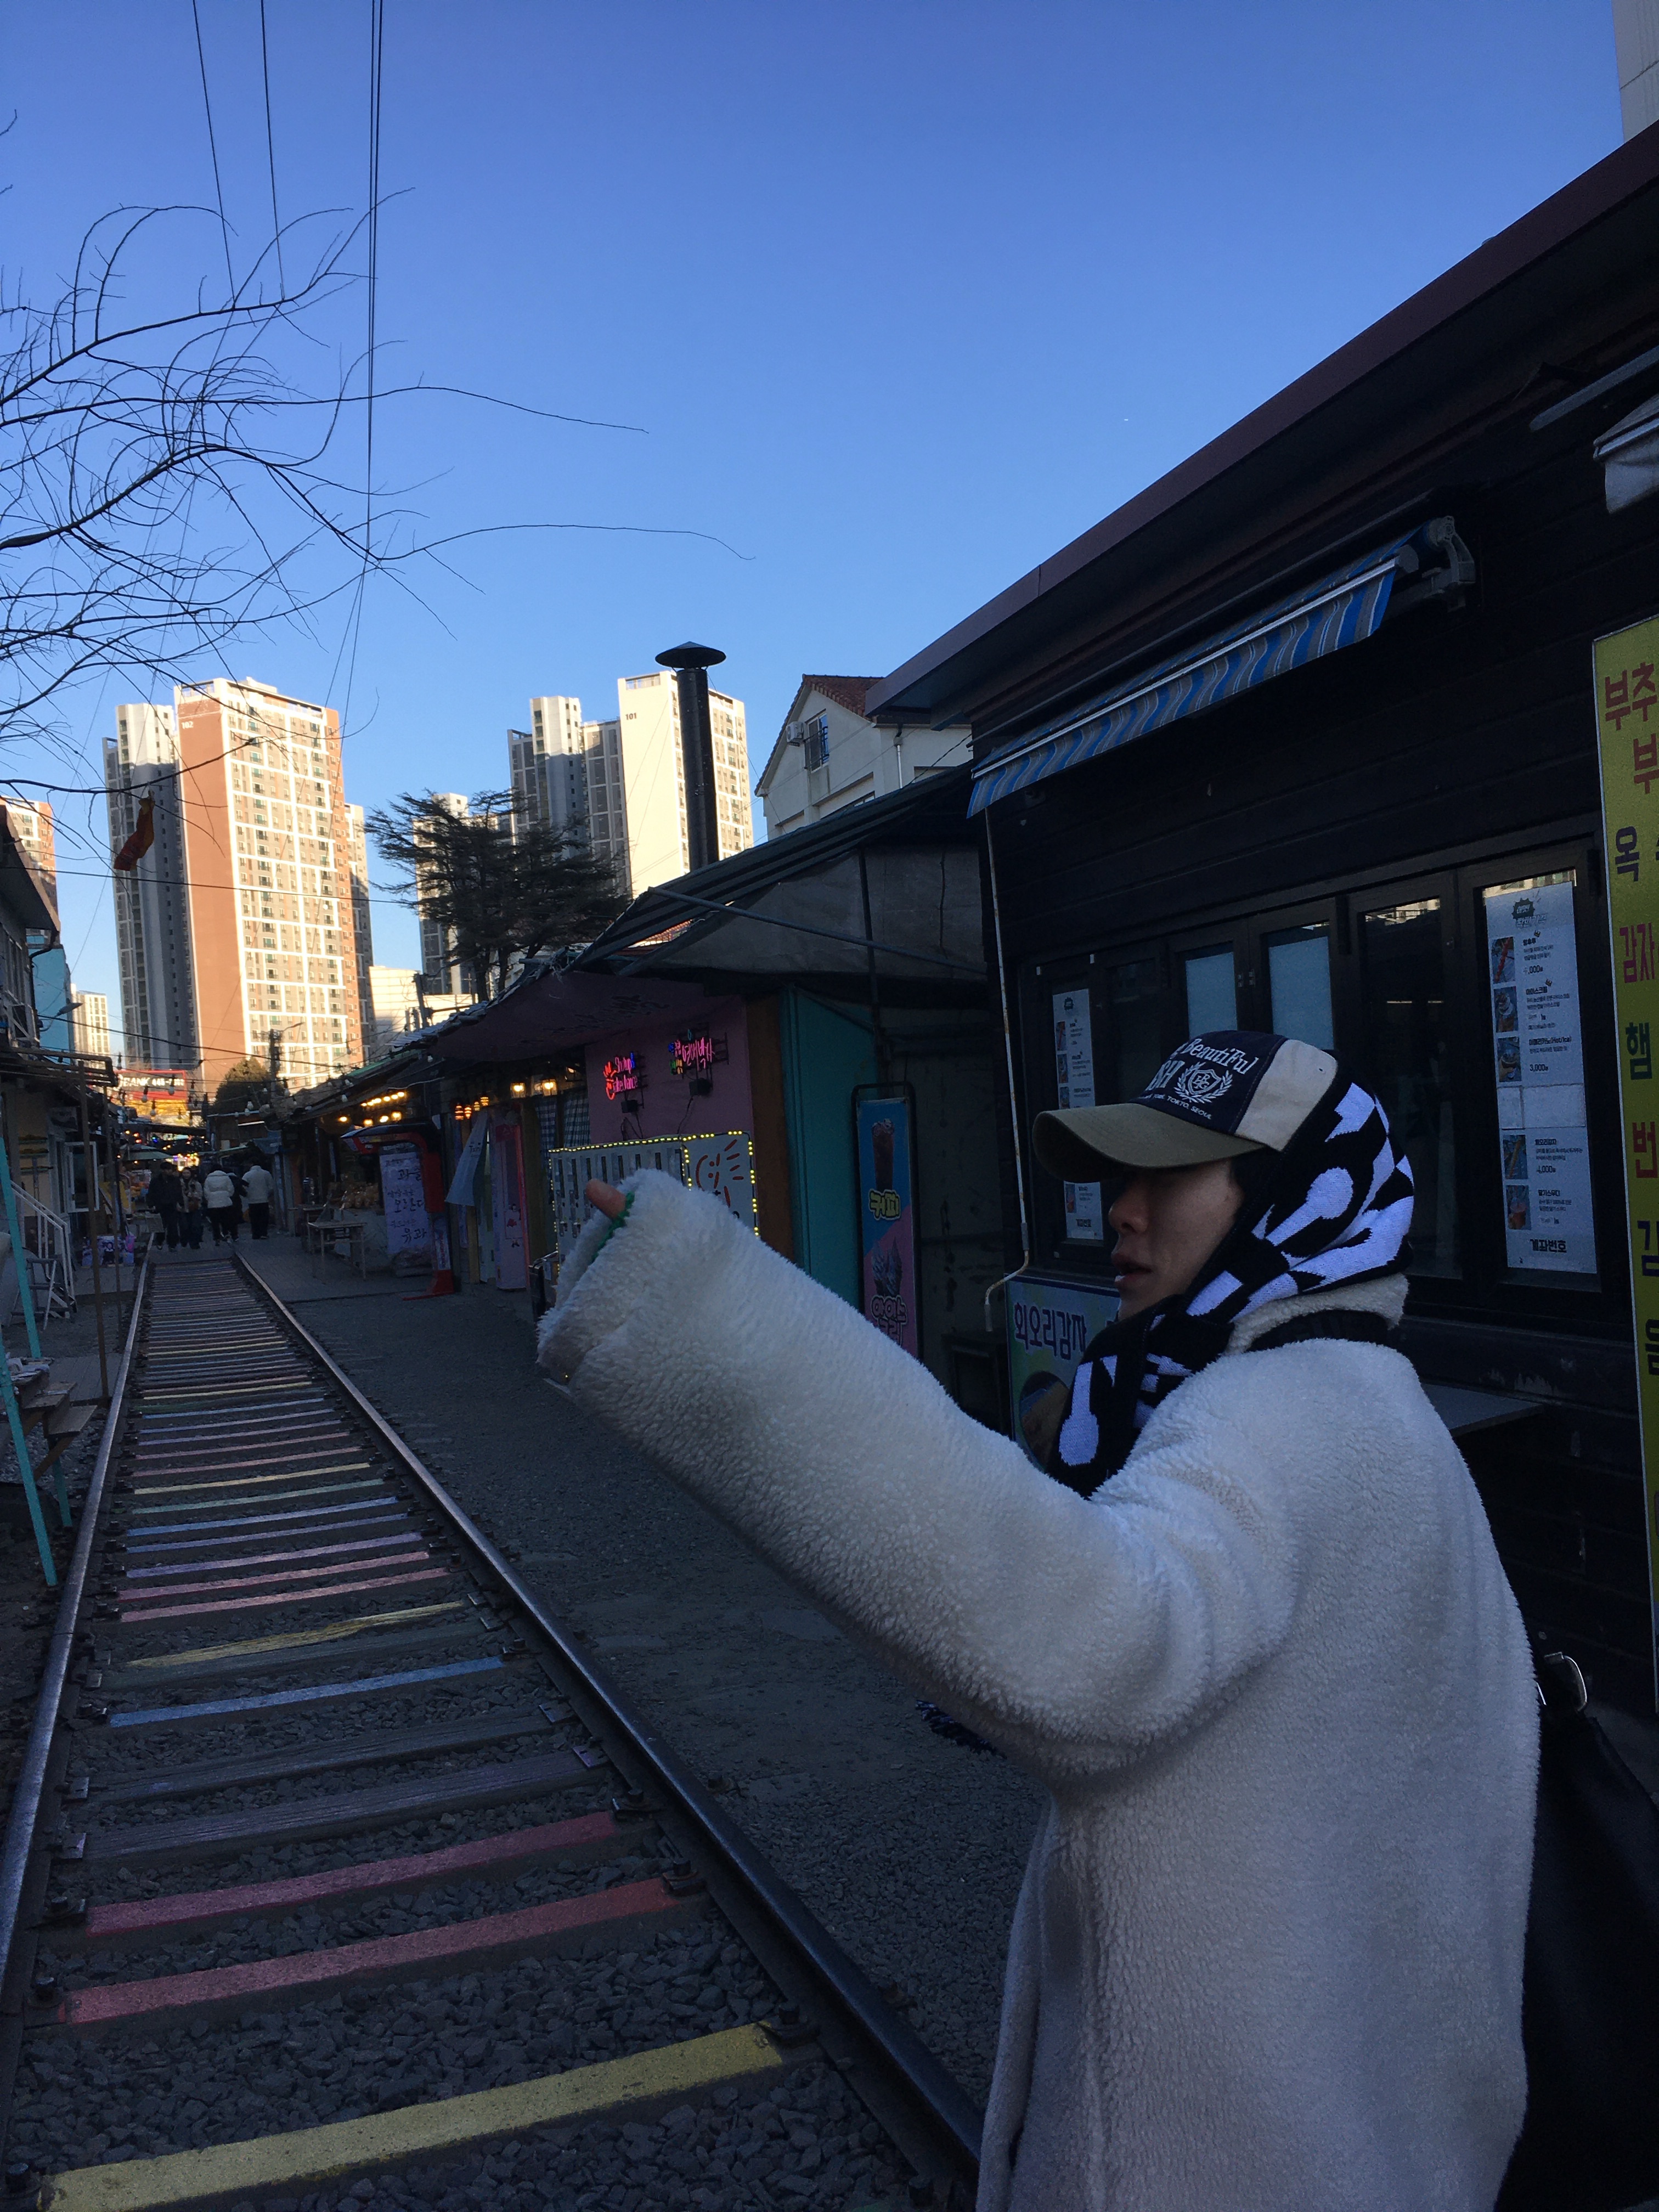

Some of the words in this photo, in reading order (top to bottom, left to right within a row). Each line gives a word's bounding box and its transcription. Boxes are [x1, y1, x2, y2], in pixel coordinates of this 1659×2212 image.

[1605, 662, 1657, 730] 부추
[182, 721, 194, 729] 102
[1626, 1022, 1652, 1080] 햄
[1530, 1239, 1567, 1253] 계좌번호
